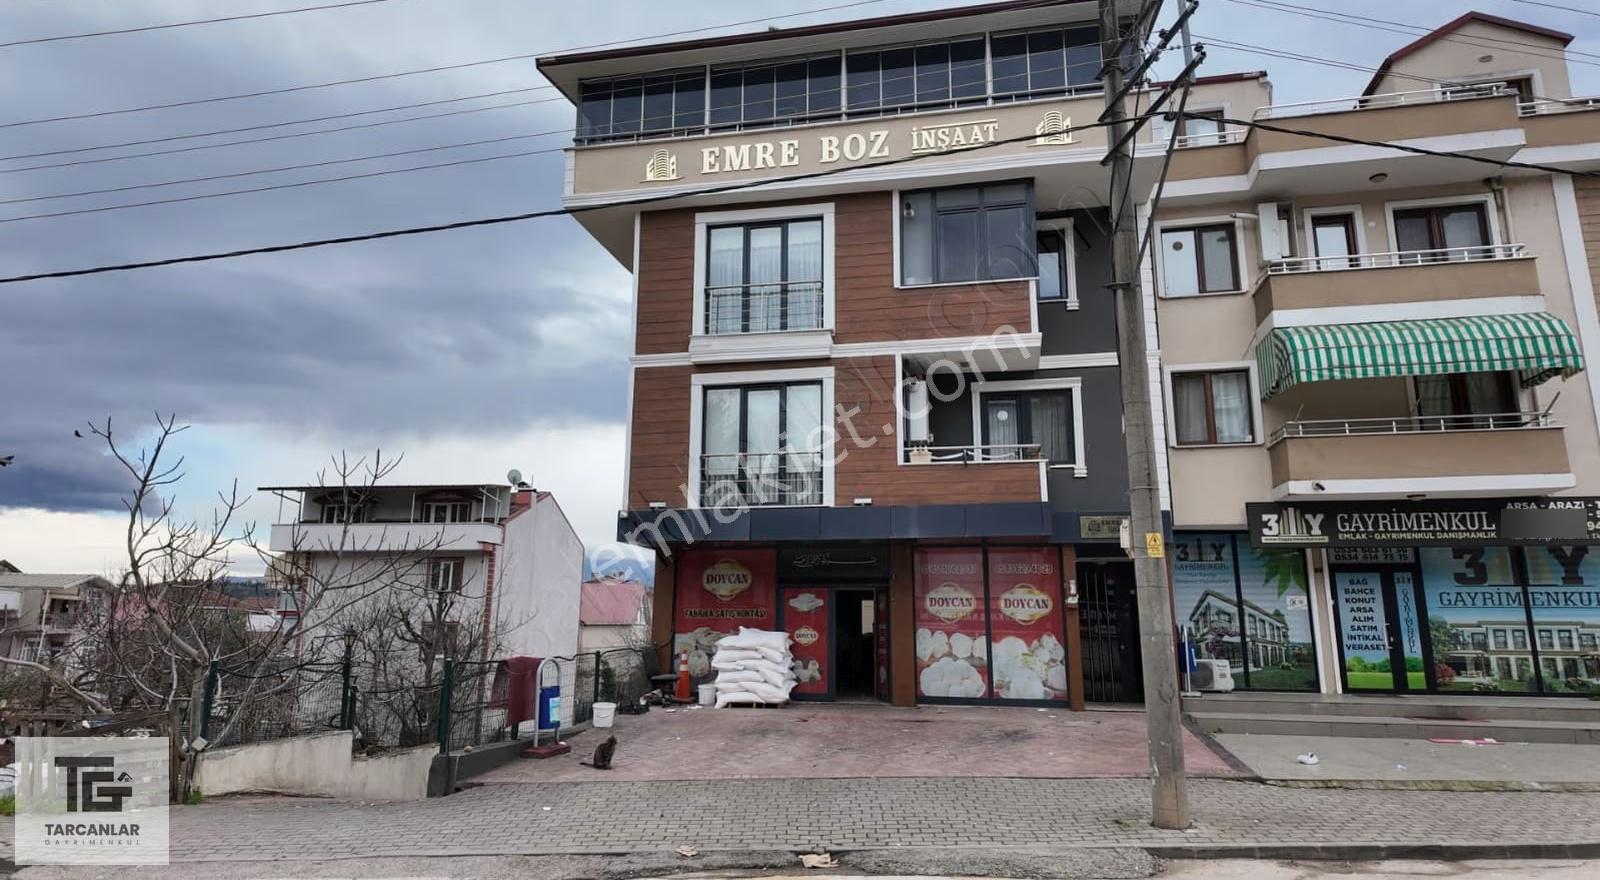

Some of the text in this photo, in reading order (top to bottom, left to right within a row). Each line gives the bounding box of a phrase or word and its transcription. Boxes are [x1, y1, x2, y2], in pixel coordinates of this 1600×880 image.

[701, 119, 999, 174] EMRE BOZ İNŞAAT
[1506, 502, 1538, 510] ARSA
[1336, 508, 1496, 532] GAYRİMENKUL
[1334, 553, 1359, 561] 0534
[705, 573, 748, 585] DOYCAN
[1348, 577, 1368, 585] BAĞ
[1344, 588, 1375, 596] BAHÇE
[928, 597, 973, 607] DOYCAN
[1003, 598, 1049, 610] DOYCAN
[1347, 633, 1384, 641] İNTİKAL
